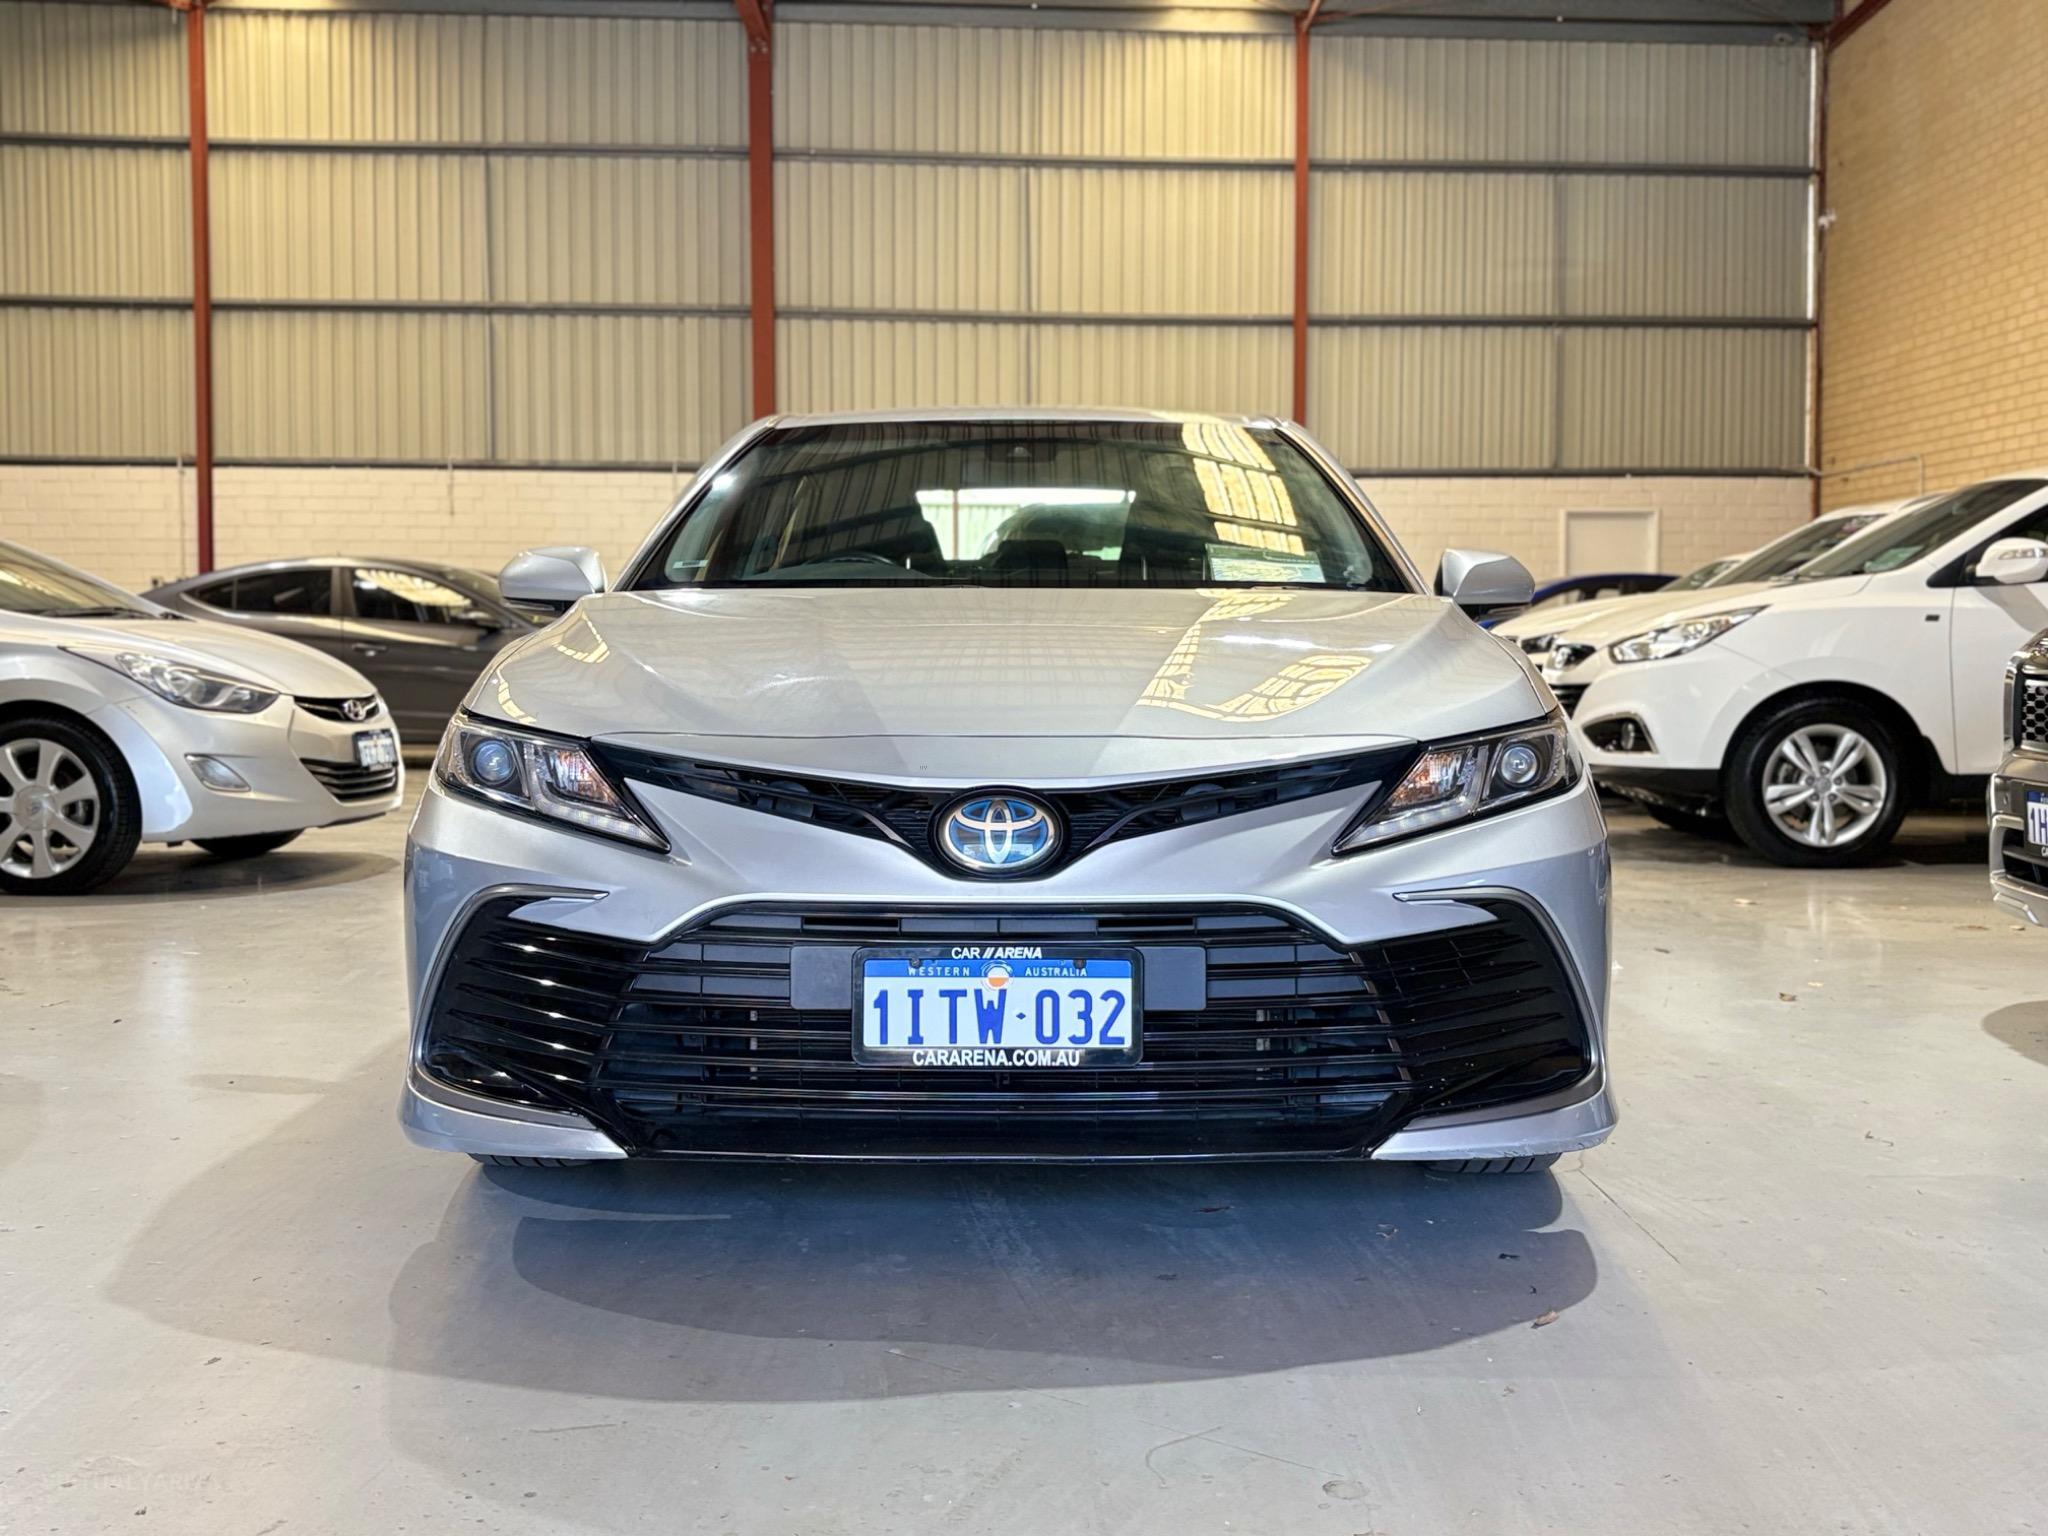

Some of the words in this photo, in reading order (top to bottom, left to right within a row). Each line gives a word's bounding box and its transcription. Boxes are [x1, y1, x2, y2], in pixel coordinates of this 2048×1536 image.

[908, 966, 970, 977] WESTERN
[1025, 966, 1088, 977] AUSTRALIA
[912, 1049, 1081, 1066] CARARENA.COM.AU
